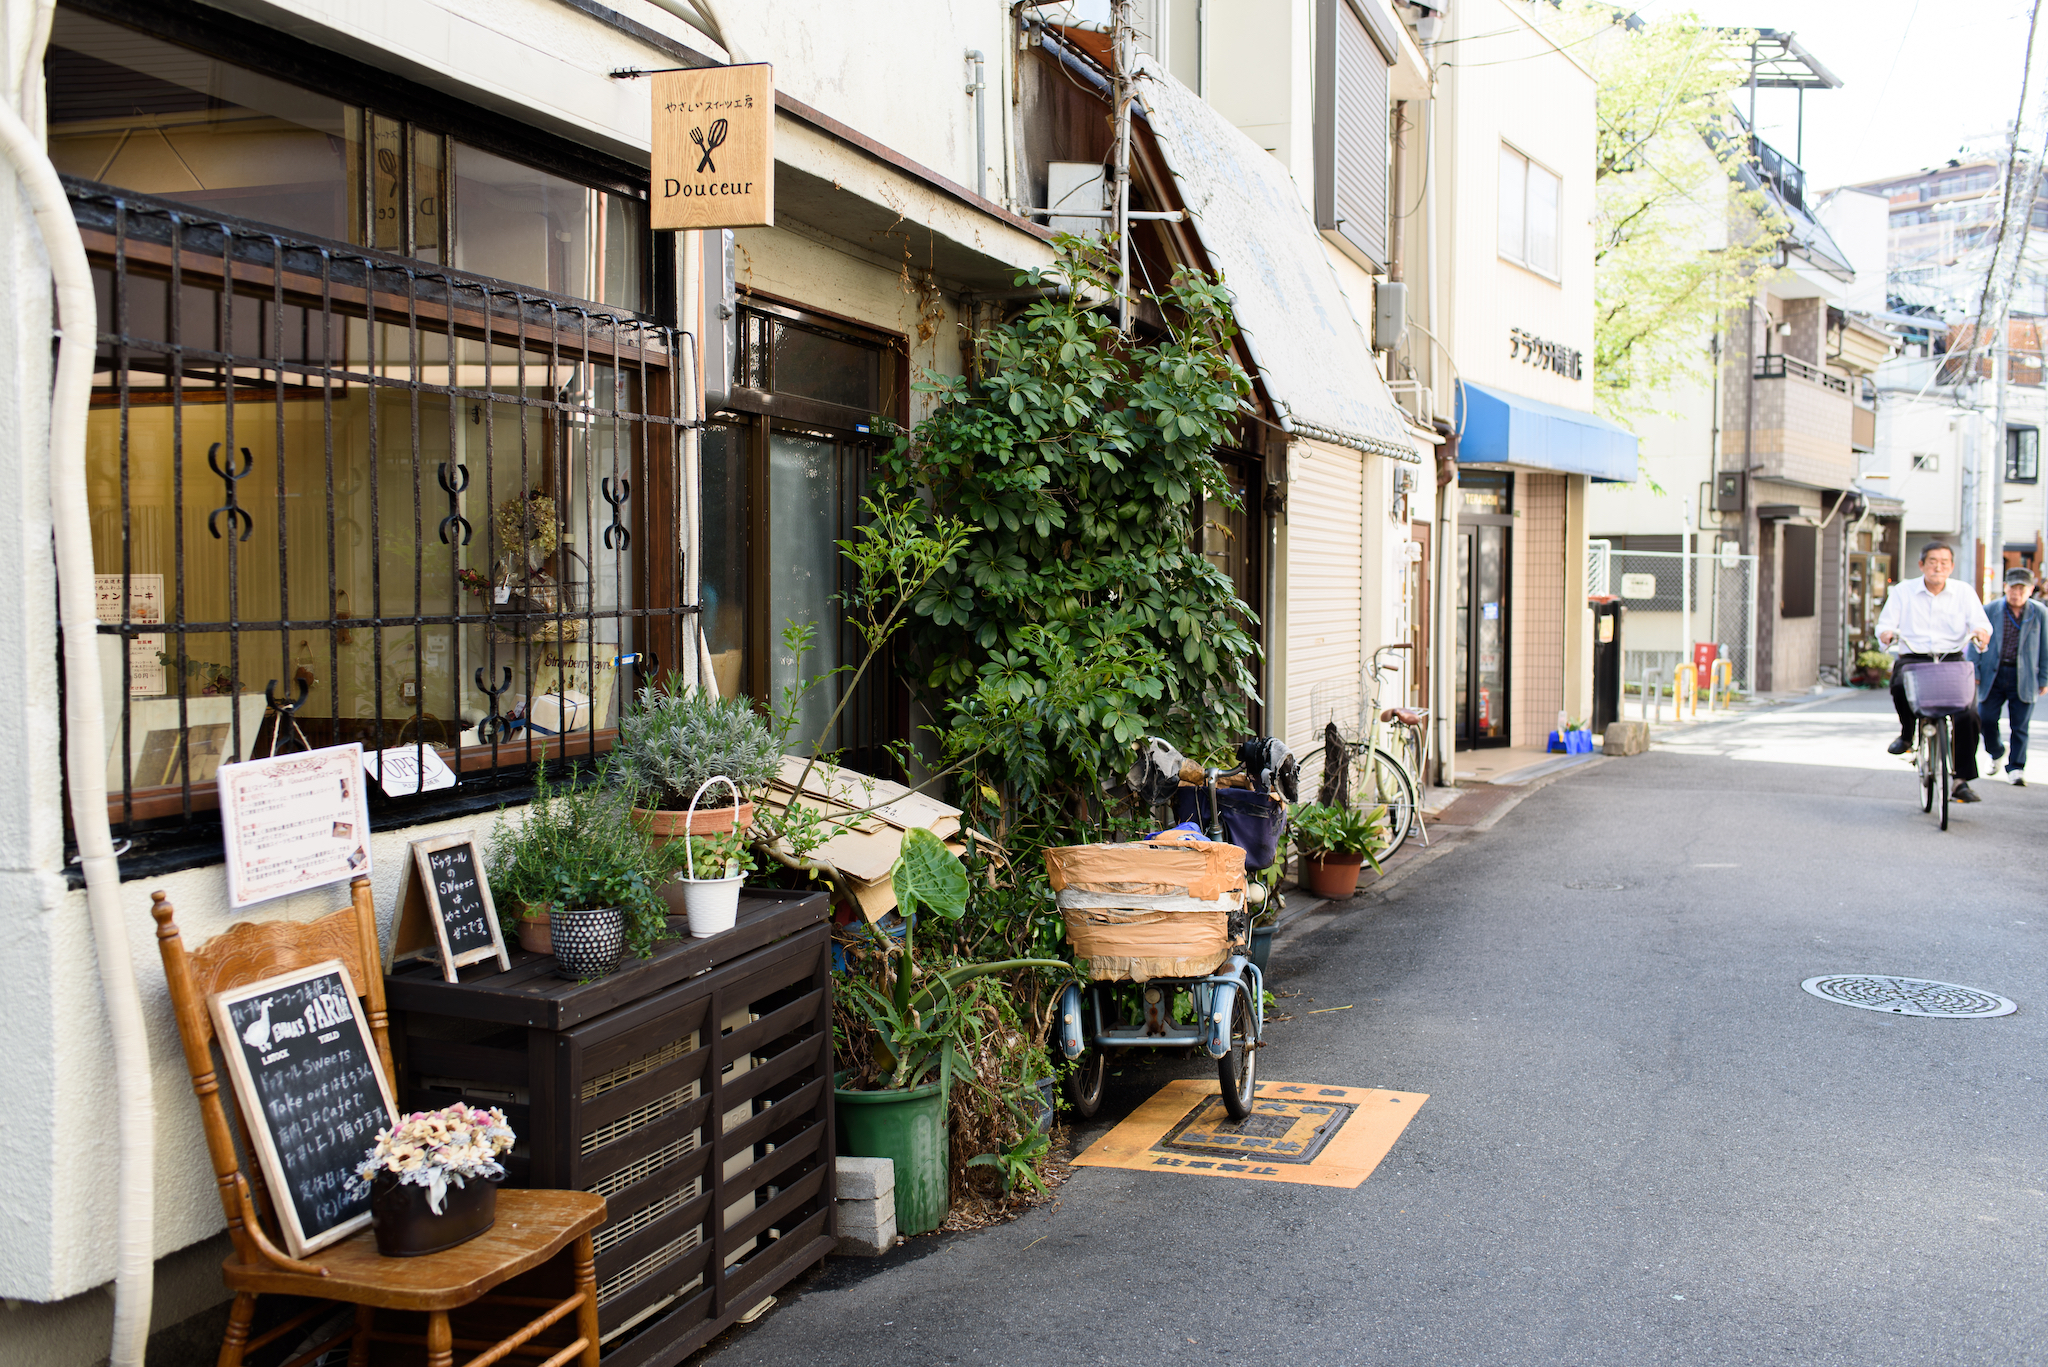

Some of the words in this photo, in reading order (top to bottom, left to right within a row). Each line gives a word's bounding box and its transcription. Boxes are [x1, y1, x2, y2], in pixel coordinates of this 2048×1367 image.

[665, 94, 753, 114] やさしいスイーツ工房
[664, 178, 753, 198] Douceur
[95, 592, 153, 600] ォンーキ
[544, 652, 589, 674] Strwberry
[382, 756, 433, 779] OPEN
[446, 868, 456, 878] の
[445, 901, 480, 922] やさしい
[303, 993, 354, 1033] FARM
[268, 1089, 303, 1118] Take
[1179, 1132, 1302, 1152] 駐車禁止
[1153, 1157, 1279, 1176] 駐車禁止
